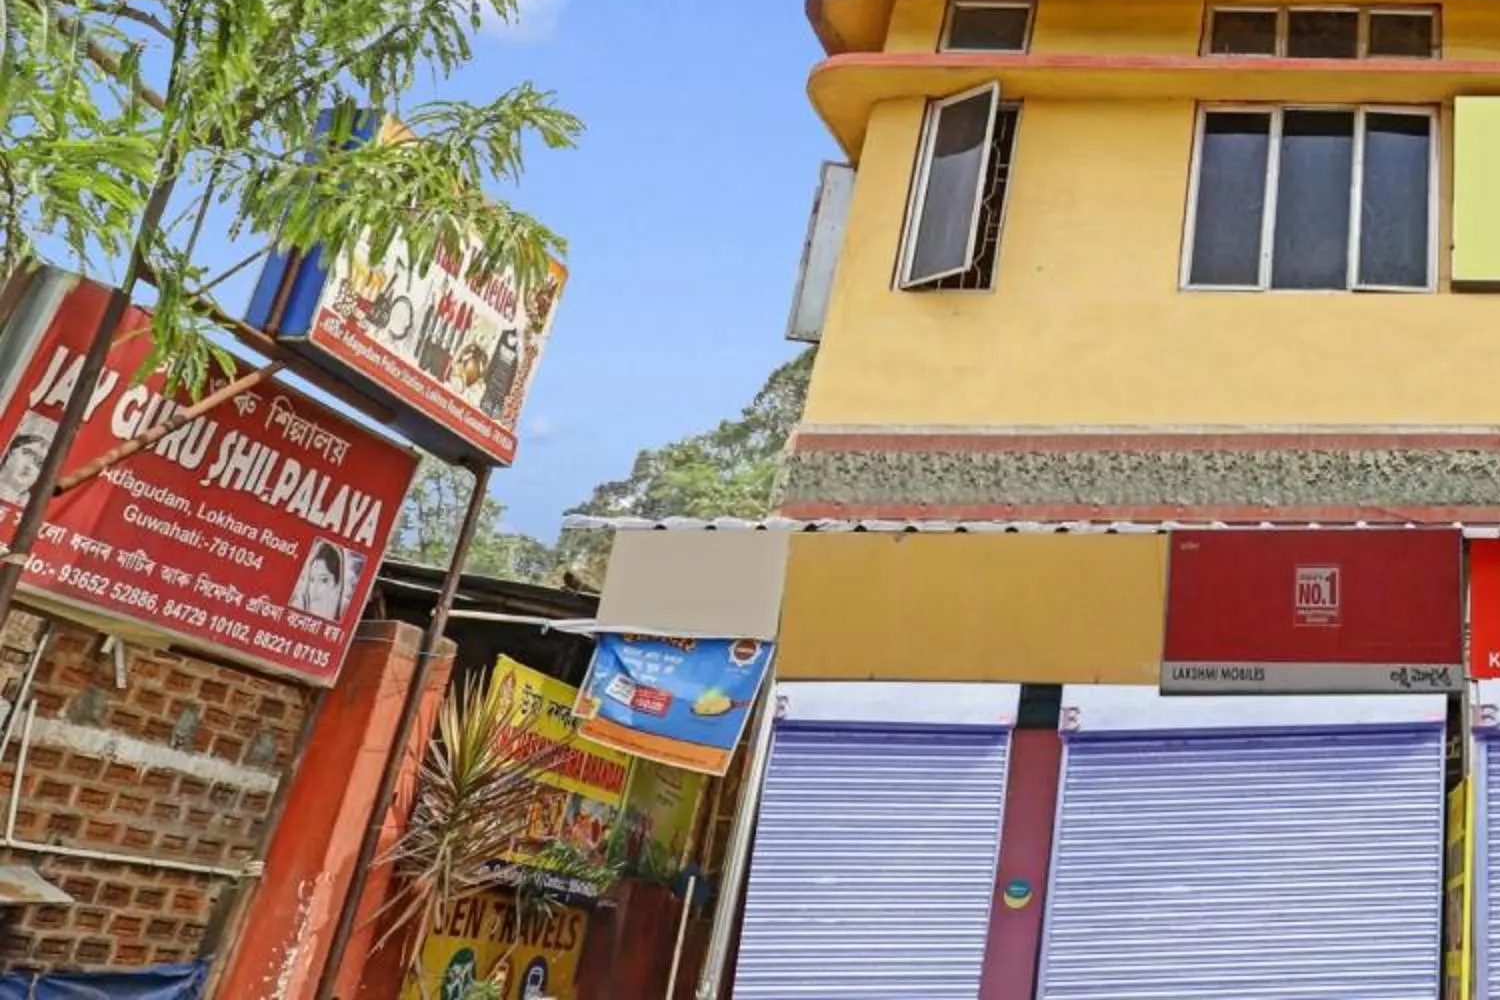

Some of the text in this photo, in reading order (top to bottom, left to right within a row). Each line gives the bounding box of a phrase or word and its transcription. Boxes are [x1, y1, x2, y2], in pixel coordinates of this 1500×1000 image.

[29, 345, 120, 422] JAY
[111, 384, 218, 469] GURU
[200, 430, 382, 547] SHILPALAYA
[196, 502, 257, 540] Lokhara
[260, 529, 299, 559] Road,
[58, 564, 109, 595] 93652
[1221, 666, 1265, 681] MOBILES
